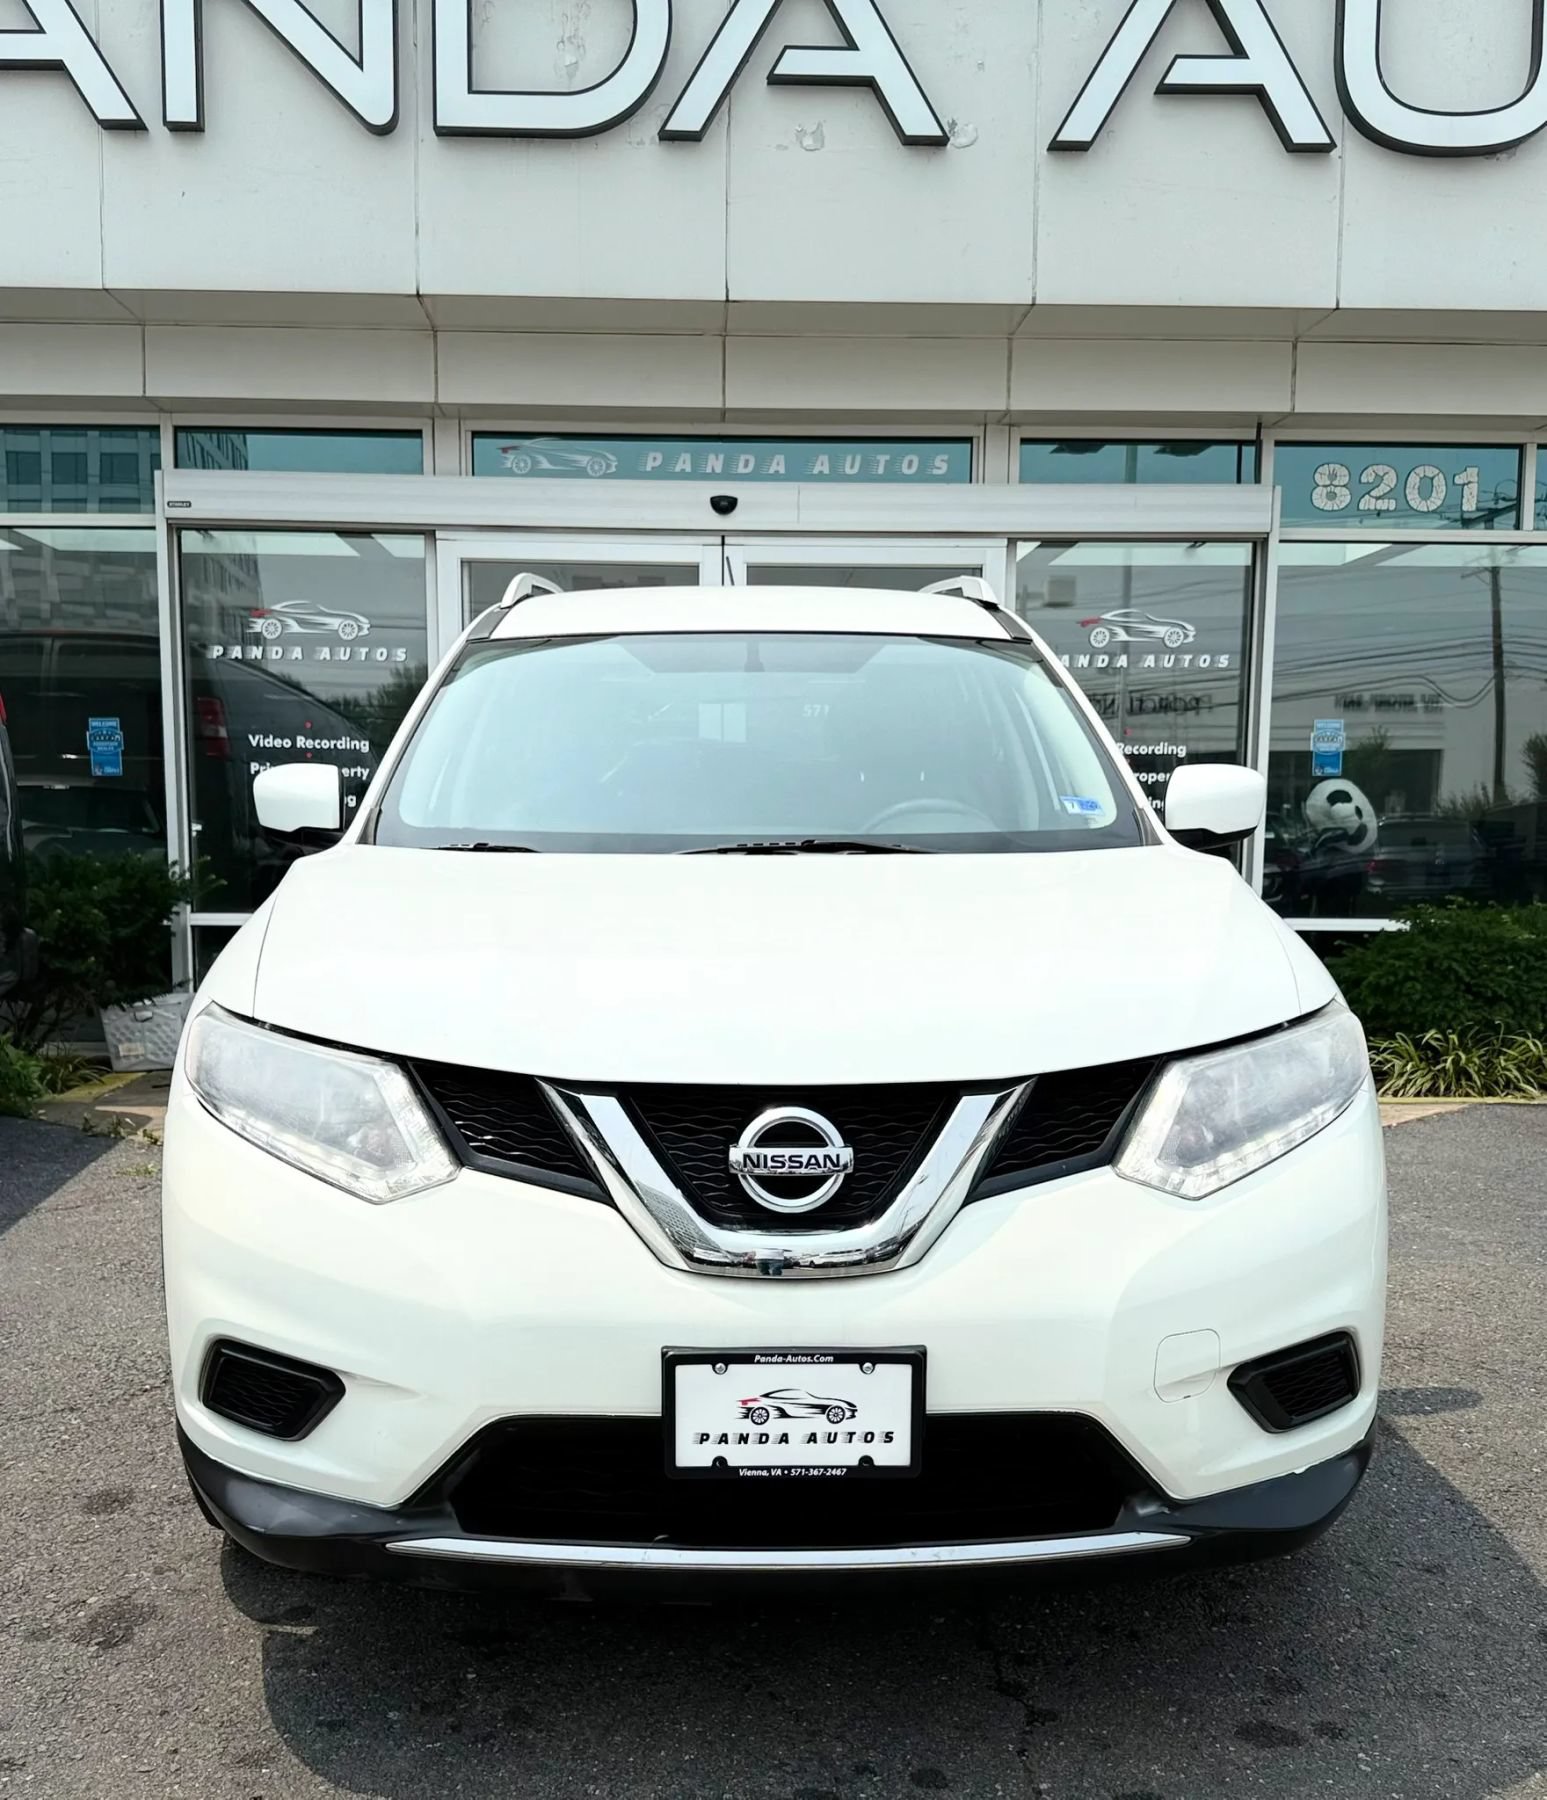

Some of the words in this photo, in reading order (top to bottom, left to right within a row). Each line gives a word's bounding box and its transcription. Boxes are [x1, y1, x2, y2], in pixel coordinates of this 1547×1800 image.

[643, 452, 786, 475] PANDA
[809, 454, 949, 476] AUTOS
[1311, 462, 1479, 513] 8201
[211, 645, 304, 660] PANDA
[318, 646, 407, 662] AUTOS
[1060, 654, 1128, 668] ANDA
[1143, 654, 1230, 668] AUTOS
[248, 734, 292, 748] Video
[296, 735, 370, 753] Recording
[341, 766, 370, 780] erty
[1134, 772, 1171, 785] roper
[743, 1153, 840, 1169] NISSAN
[754, 1354, 834, 1363] Panda-Autos.Com
[696, 1432, 790, 1445] PANDA
[804, 1431, 894, 1444] AUTOS
[739, 1468, 770, 1477] Vienna,
[770, 1468, 783, 1476] VA
[790, 1468, 847, 1476] 571-367-2467
